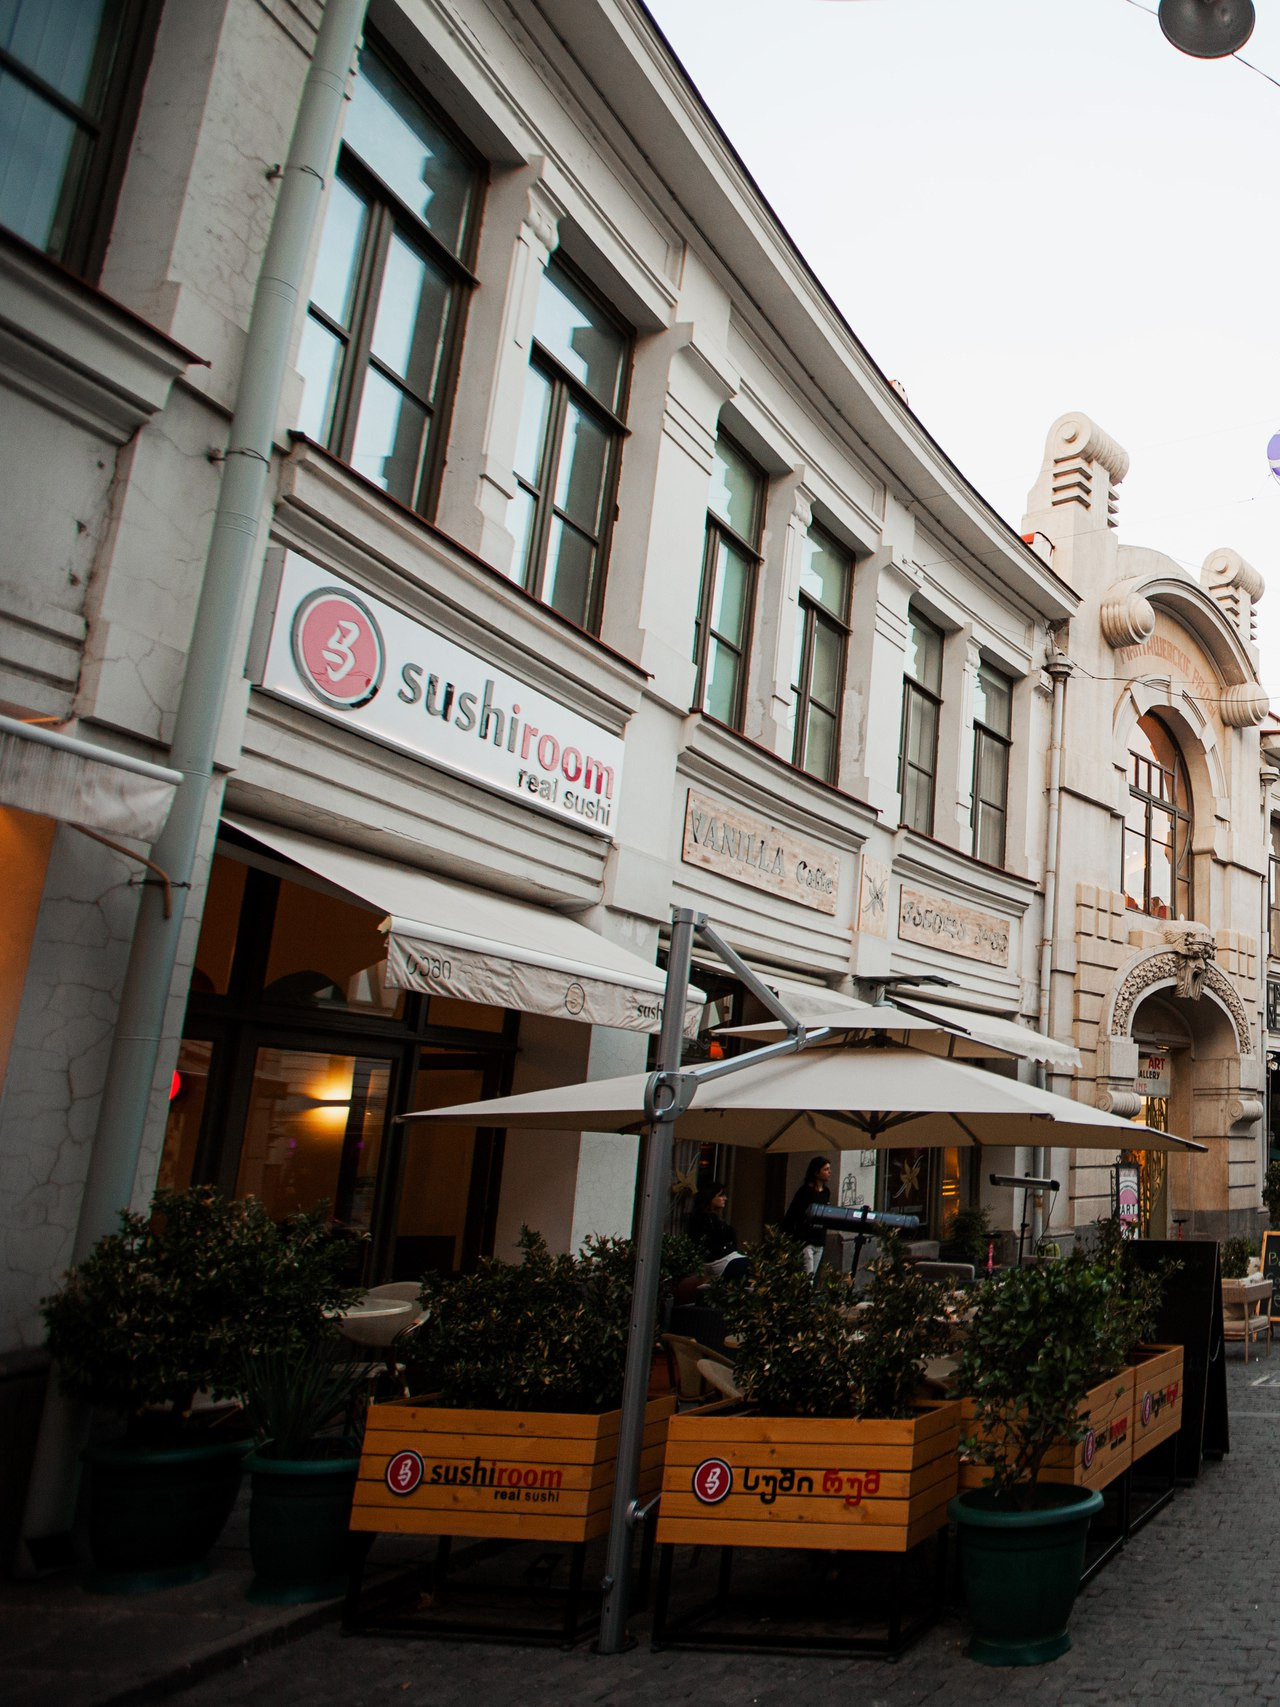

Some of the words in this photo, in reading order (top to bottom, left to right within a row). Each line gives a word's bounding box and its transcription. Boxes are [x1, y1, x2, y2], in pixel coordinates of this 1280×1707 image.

[398, 662, 614, 799] sushiroom
[517, 769, 558, 802] real
[563, 790, 611, 826] sushi
[692, 808, 786, 878] VANILLA
[637, 1001, 664, 1021] sush
[1138, 1069, 1161, 1080] ALLERY
[1148, 1057, 1165, 1070] ART
[1120, 1204, 1136, 1215] ART
[430, 1456, 563, 1488] sushiroom
[493, 1489, 520, 1500] real
[524, 1490, 560, 1502] sushi
[743, 1467, 814, 1504] სუში
[821, 1468, 881, 1506] რუმ
